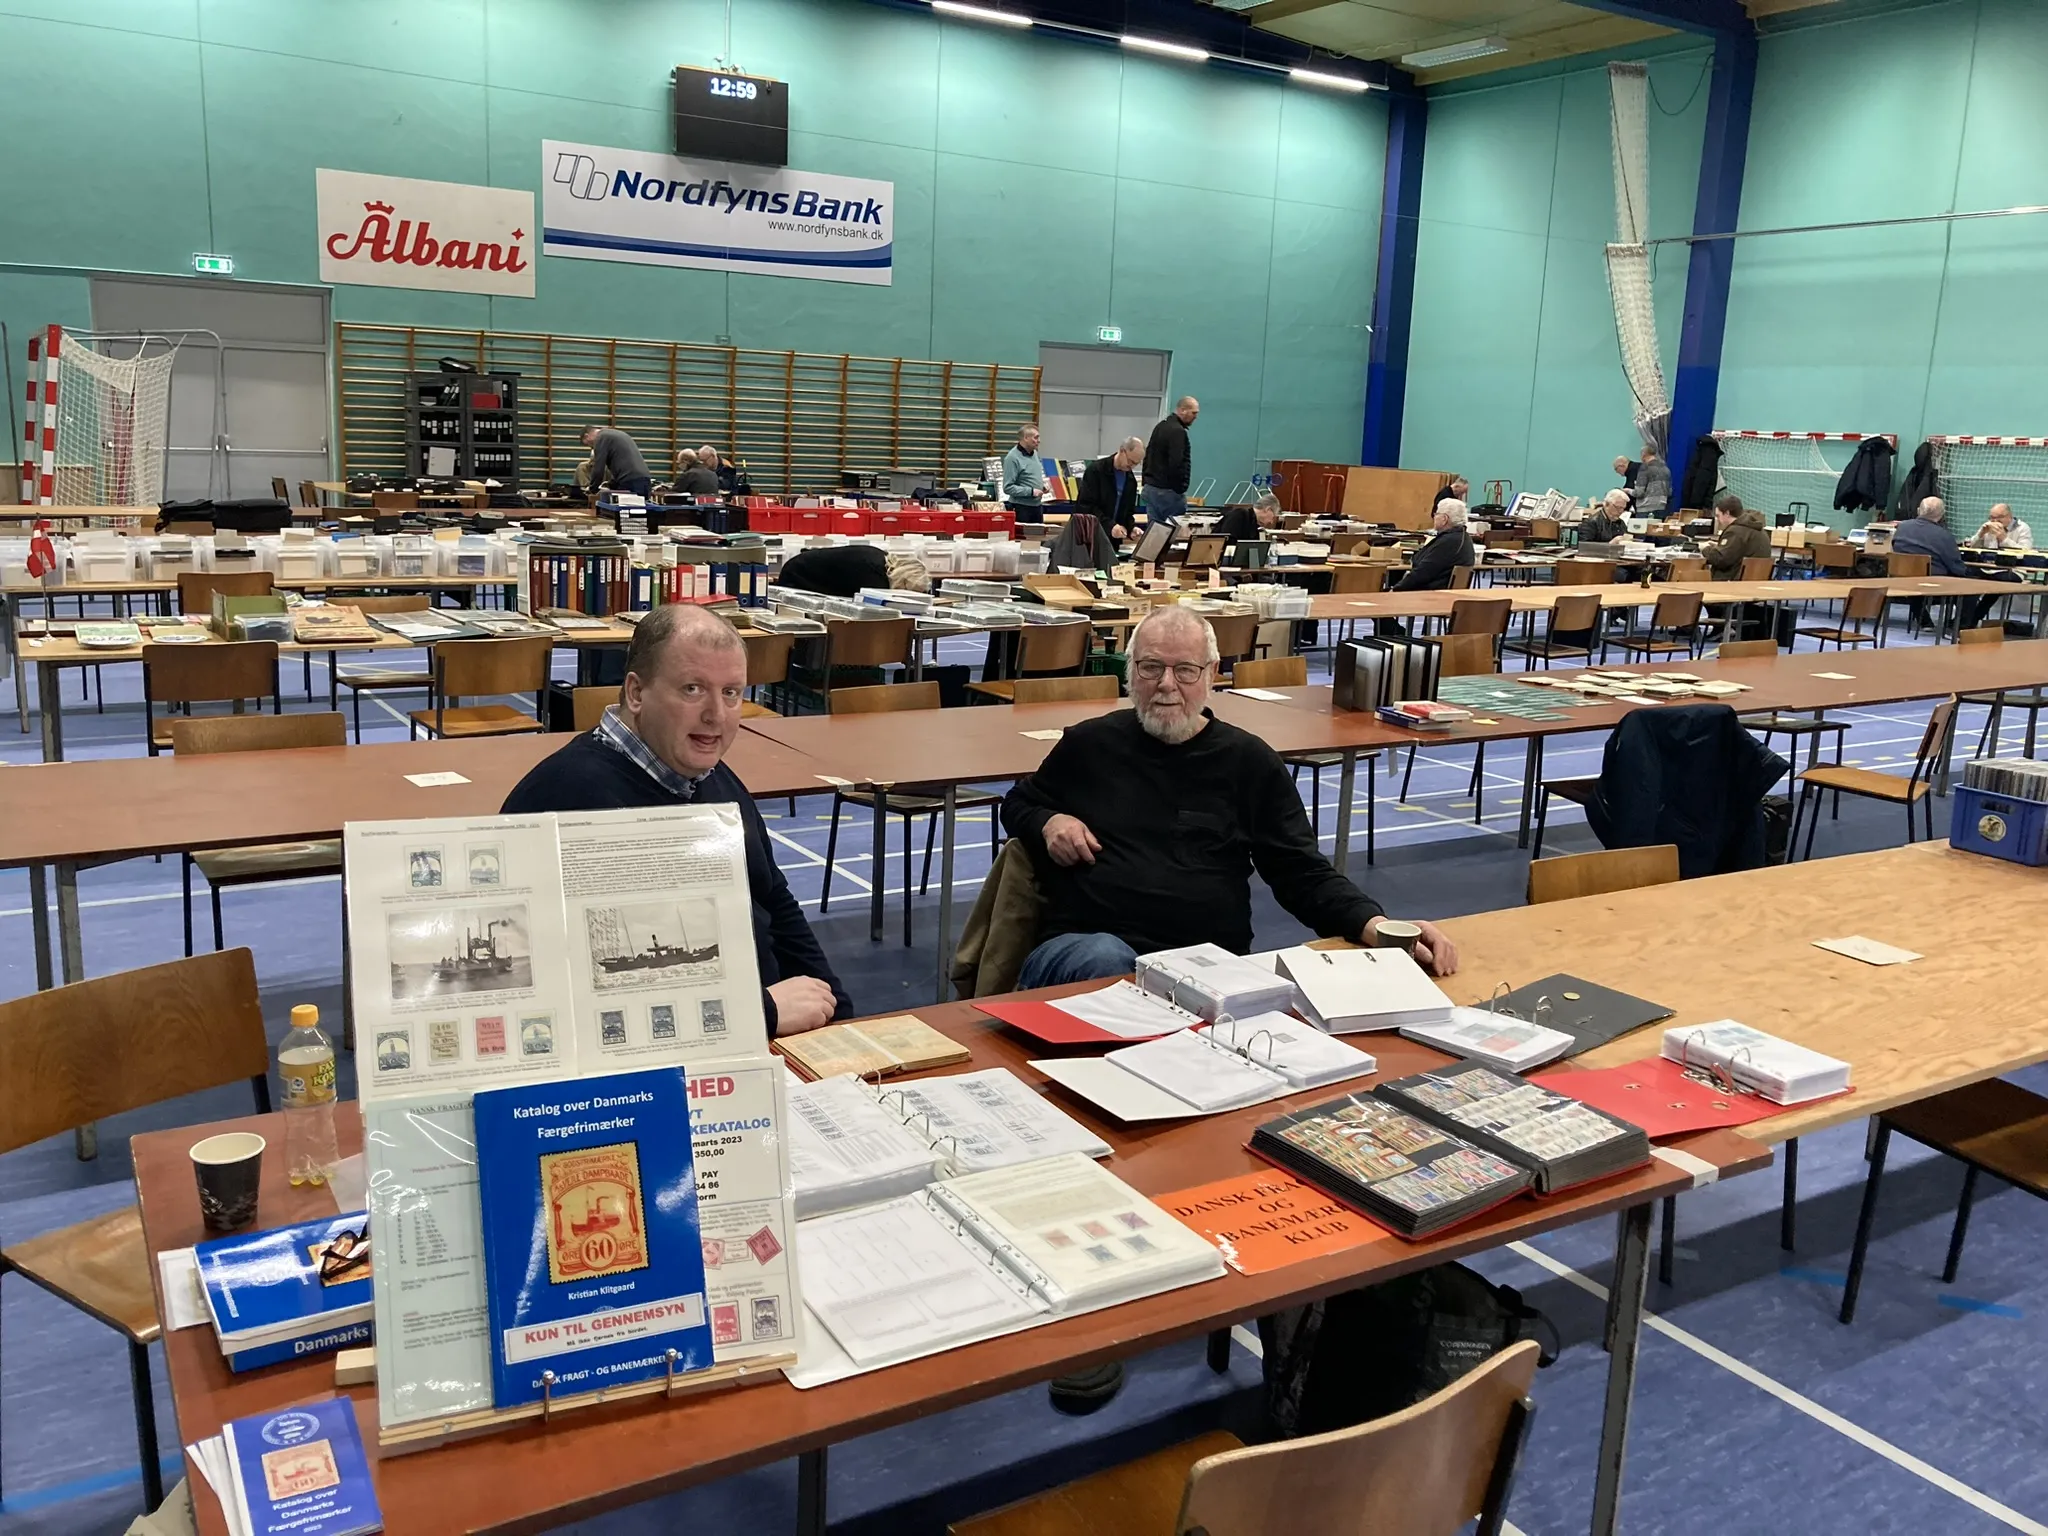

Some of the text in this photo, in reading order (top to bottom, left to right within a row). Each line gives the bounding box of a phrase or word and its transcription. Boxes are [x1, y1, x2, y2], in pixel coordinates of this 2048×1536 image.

[710, 77, 757, 100] 12:59
[768, 219, 884, 241] www.nordfynsbank.dk
[327, 212, 528, 273] Albani
[513, 1090, 654, 1119] Katalog over Danmarks
[537, 1117, 636, 1139] Færgefrimærker
[690, 1118, 771, 1135] KEKATALOG
[692, 1136, 742, 1147] marts 2023
[695, 1148, 725, 1158] 350,00
[701, 1171, 719, 1179] PAY
[708, 1181, 720, 1189] 86
[1174, 1180, 1303, 1217] DANSK FRA
[1258, 1198, 1295, 1213] OG
[1283, 1221, 1350, 1244] KLUB
[562, 1237, 638, 1262] ØRE 60 ØRE
[568, 1281, 635, 1300] Kristian Klitgaard
[525, 1302, 686, 1344] KUN TIL GENNEMSYN
[295, 1327, 369, 1353] Danmarks
[532, 1375, 561, 1389] DAK
[562, 1370, 590, 1382] FRAGT
[596, 1367, 609, 1376] OG
[610, 1351, 684, 1373] BANEMÆRKEB
[272, 1489, 338, 1511] Katalog over
[281, 1500, 335, 1519] Danmarks
[268, 1506, 353, 1533] Færgefrimærker
